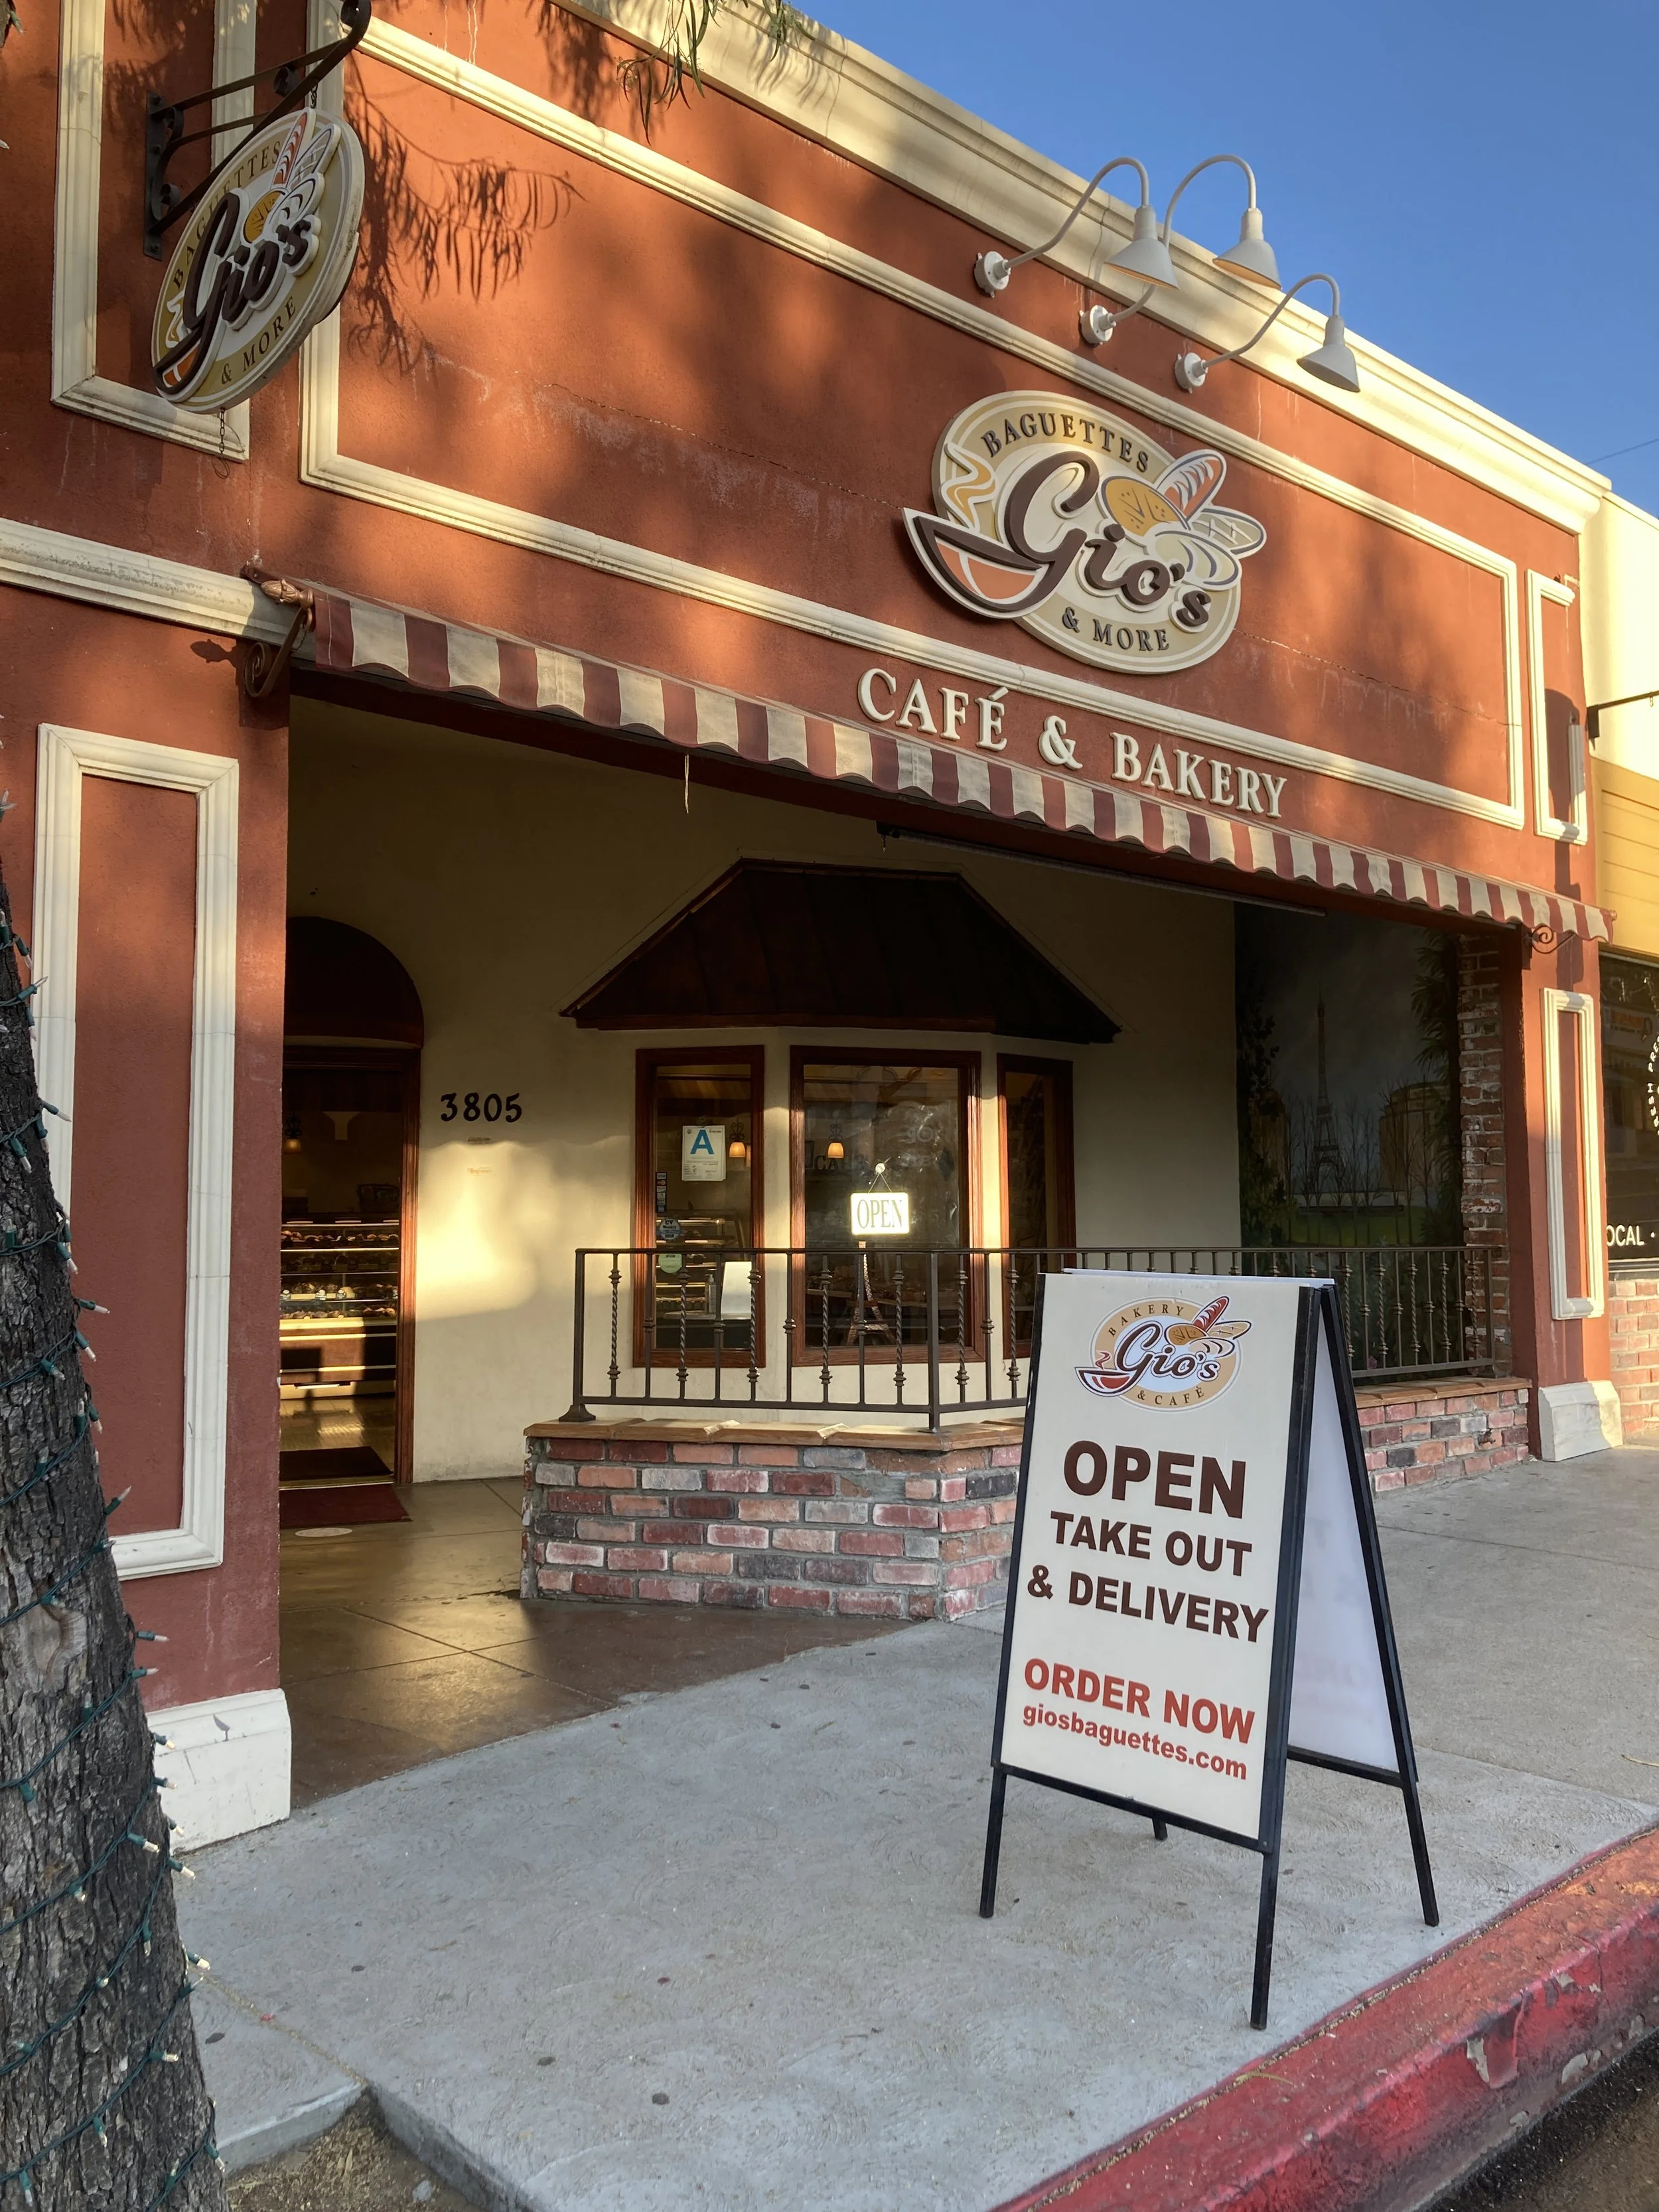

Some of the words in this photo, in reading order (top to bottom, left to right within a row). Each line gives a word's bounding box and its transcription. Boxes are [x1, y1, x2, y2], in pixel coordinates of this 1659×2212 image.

[155, 192, 312, 394] Gio's
[221, 362, 232, 385] &
[243, 296, 297, 374] MORE
[981, 412, 1149, 473] BAGUETTES
[913, 451, 1212, 627] Gio's
[1062, 607, 1080, 633] &
[1092, 619, 1170, 652] MORE
[857, 668, 1009, 751] CAFÉ
[1039, 715, 1083, 770] &
[1110, 732, 1287, 818] BAKERY
[441, 1092, 522, 1123] 3805
[1648, 1082, 1659, 1136] RESH
[690, 1130, 714, 1155] A
[857, 1199, 902, 1228] OPEN
[1108, 1303, 1185, 1337] BAKERY
[1078, 1323, 1218, 1394] Gio's
[1137, 1390, 1145, 1400] &
[1064, 1440, 1246, 1519] OPEN
[1050, 1511, 1152, 1560] TAKE
[1165, 1530, 1252, 1577] OUT
[1027, 1565, 1054, 1599] &
[1068, 1571, 1269, 1643] DELIVERY
[1025, 1658, 1151, 1718] ORDER
[1164, 1690, 1256, 1744] NOW
[1023, 1703, 1248, 1780] giosbaguettes.com
